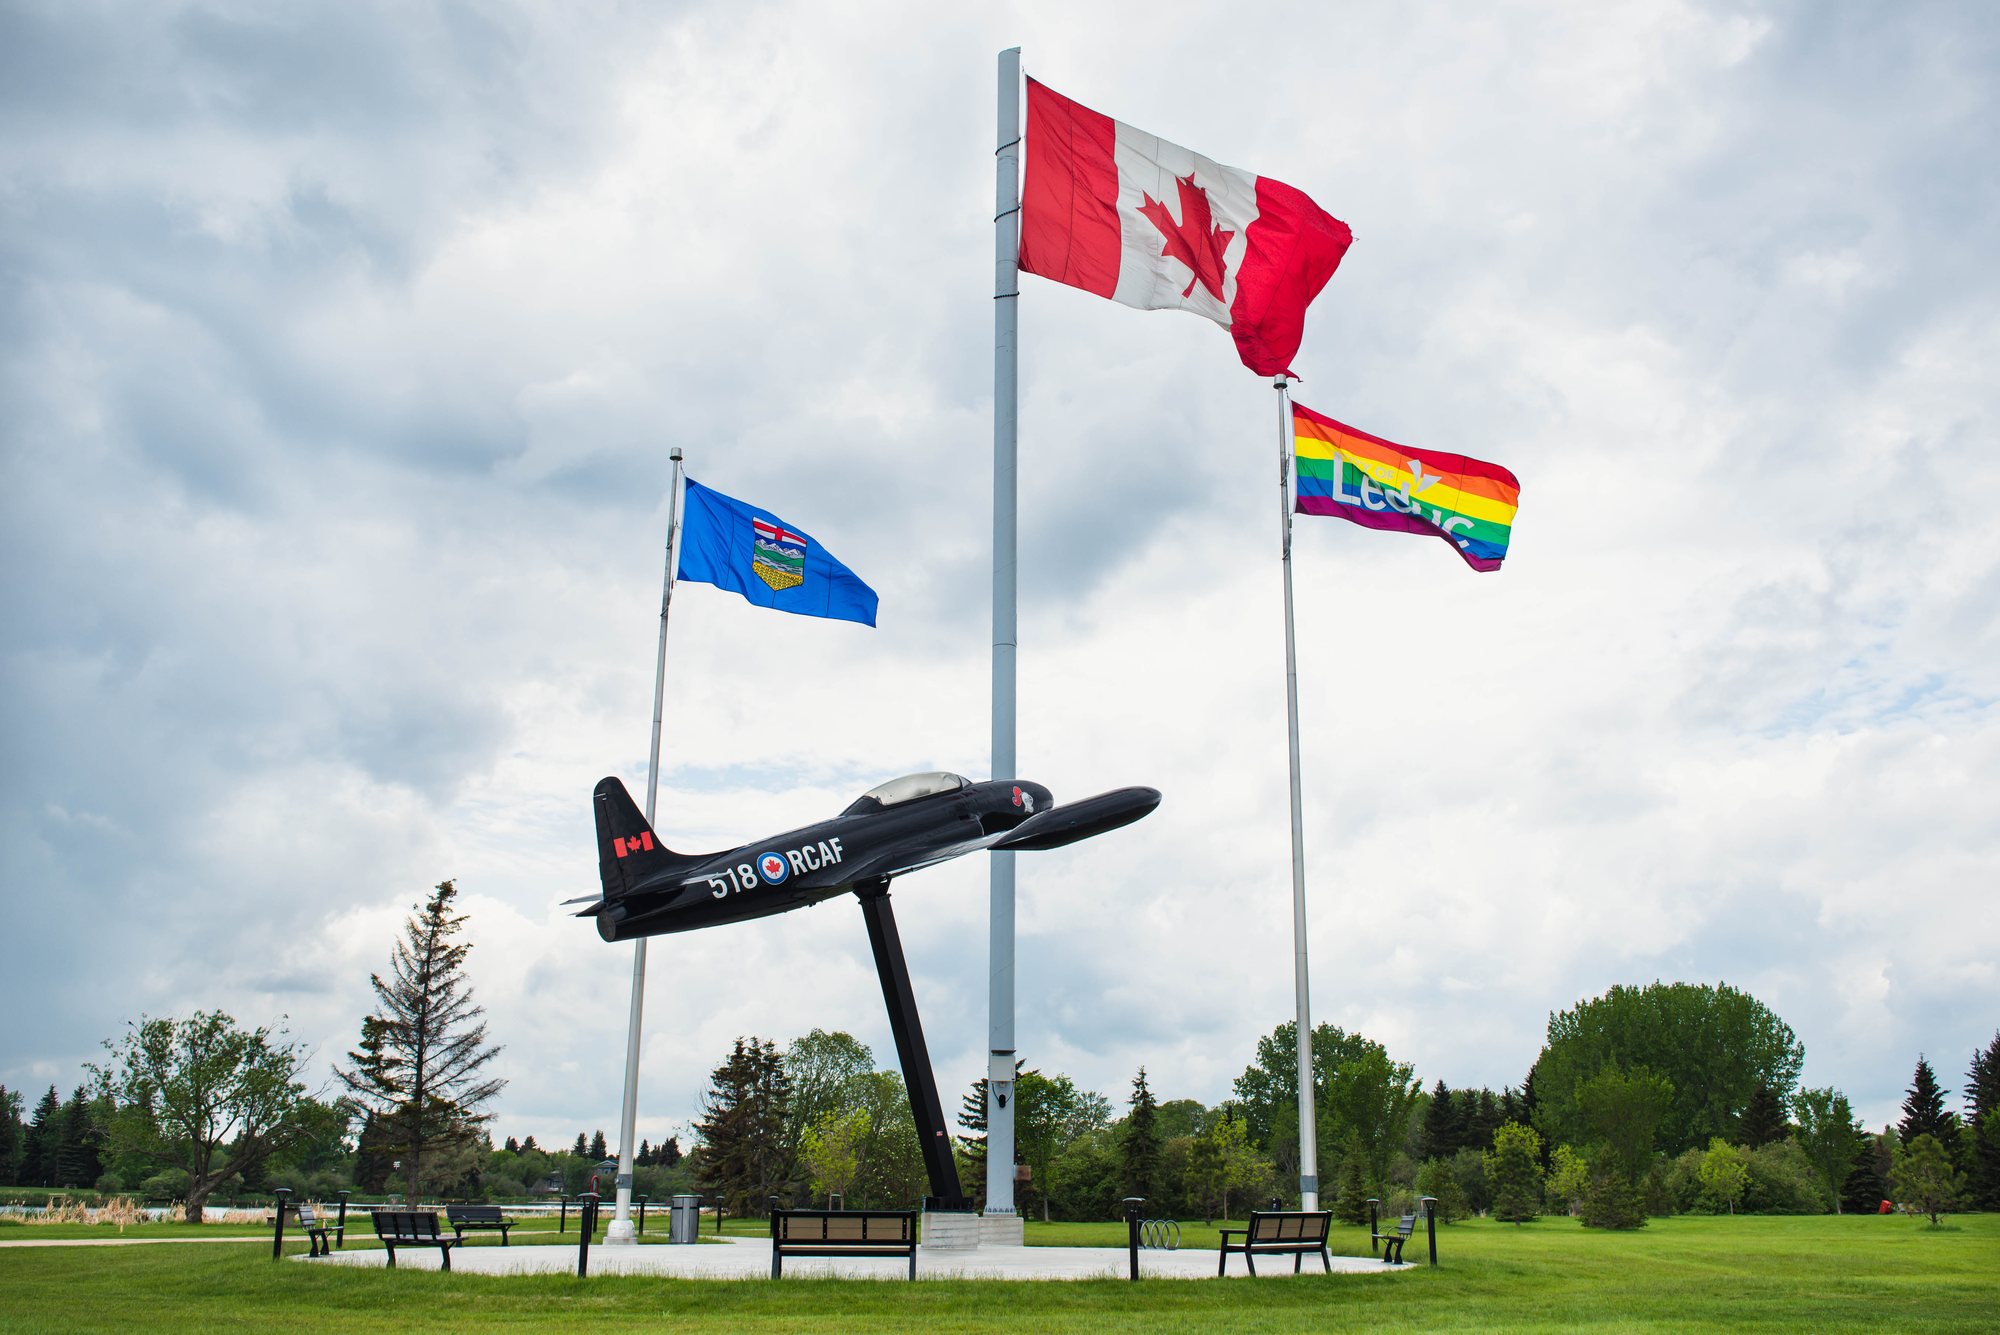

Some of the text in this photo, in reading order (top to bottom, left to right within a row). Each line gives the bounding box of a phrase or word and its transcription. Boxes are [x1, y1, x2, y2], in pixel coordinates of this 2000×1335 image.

[1375, 466, 1397, 481] OF
[707, 837, 844, 899] 518 RCAF
